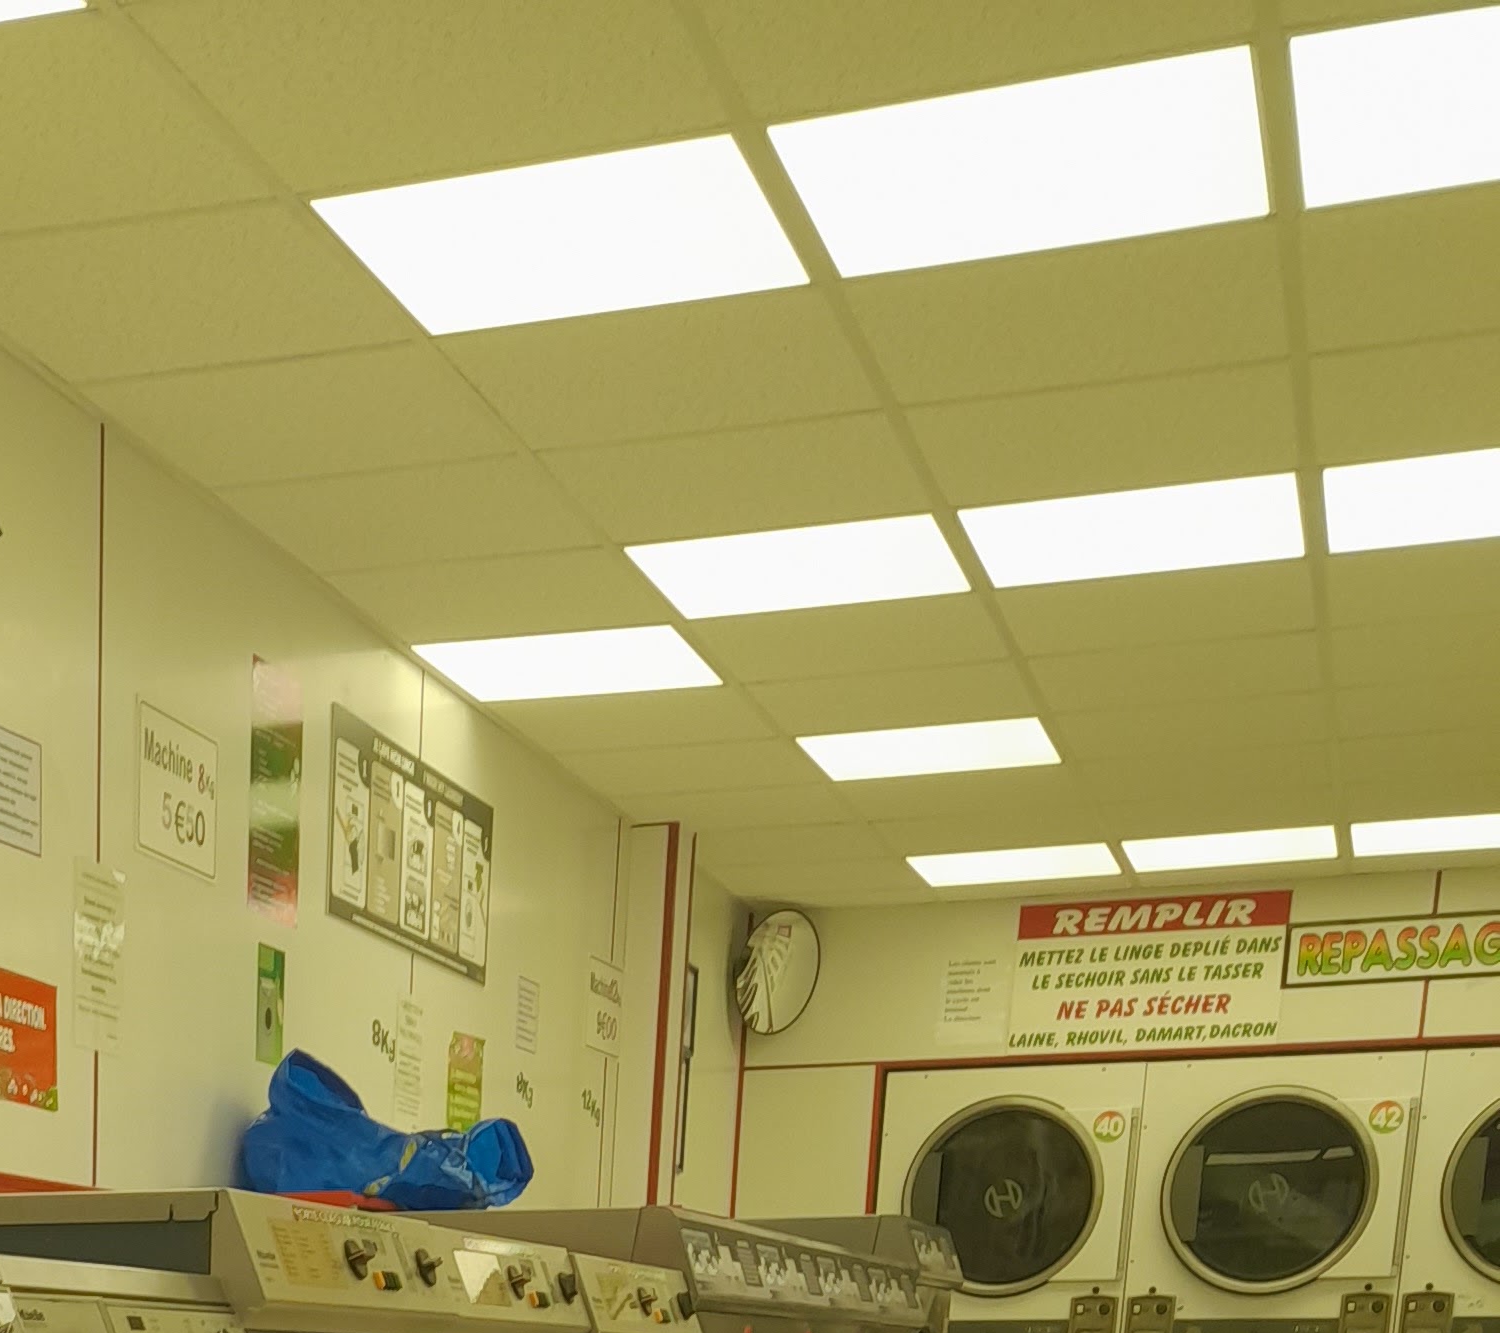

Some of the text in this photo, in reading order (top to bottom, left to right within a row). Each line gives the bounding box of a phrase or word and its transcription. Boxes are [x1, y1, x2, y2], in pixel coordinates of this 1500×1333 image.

[144, 727, 193, 783] Machine
[162, 792, 206, 846] 5€50
[1052, 898, 1257, 936] REMPLIR
[1018, 934, 1283, 968] METTEZ LE LINGE DEPLIÉ DANS
[1032, 962, 1264, 991] LE SECHOIR SANS LE TASSER
[1056, 990, 1232, 1021] NE PAS SÉCHER
[1009, 1031, 1059, 1049] LAINE,
[1065, 1028, 1128, 1046] RHOVIL,
[1208, 1021, 1278, 1040] DACRON
[1096, 1115, 1125, 1138] 40
[1371, 1106, 1401, 1129] 42
